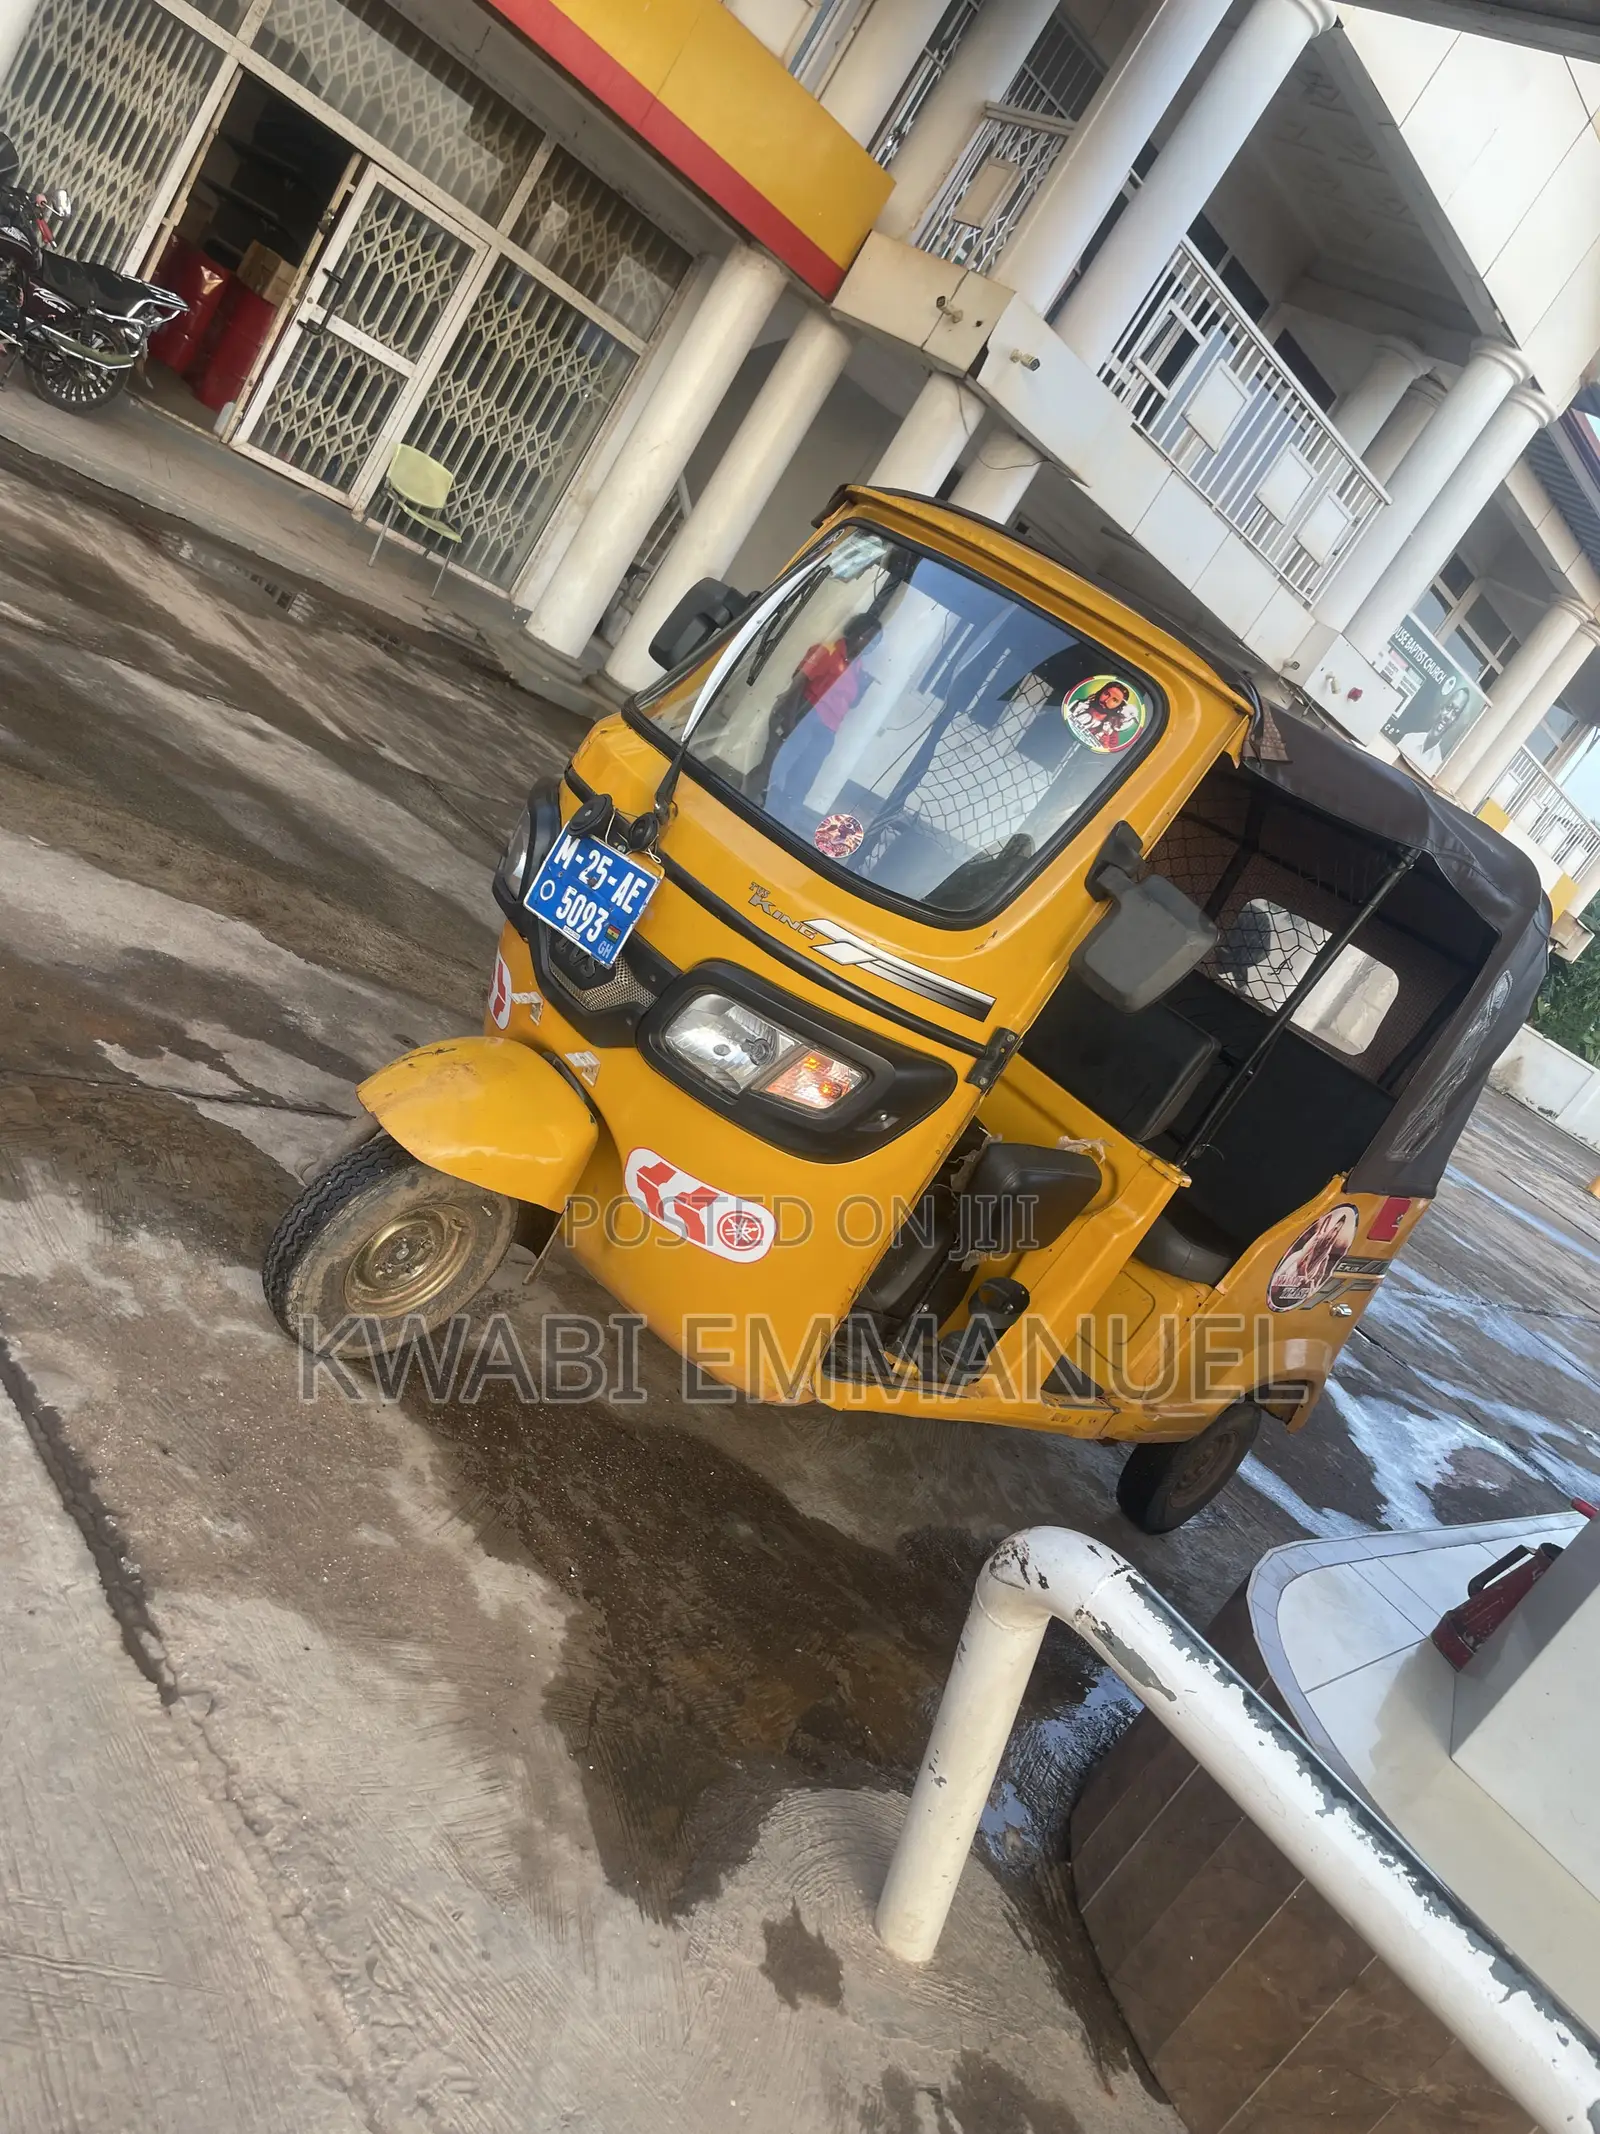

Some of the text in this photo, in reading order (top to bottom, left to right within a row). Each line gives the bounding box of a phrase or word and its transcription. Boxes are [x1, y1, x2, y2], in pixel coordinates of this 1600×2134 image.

[1403, 636, 1429, 664] BAPTIST
[1422, 656, 1447, 684] CHURCH
[553, 834, 647, 914] M-25-AE
[555, 885, 609, 943] 5093
[597, 940, 614, 959] GH
